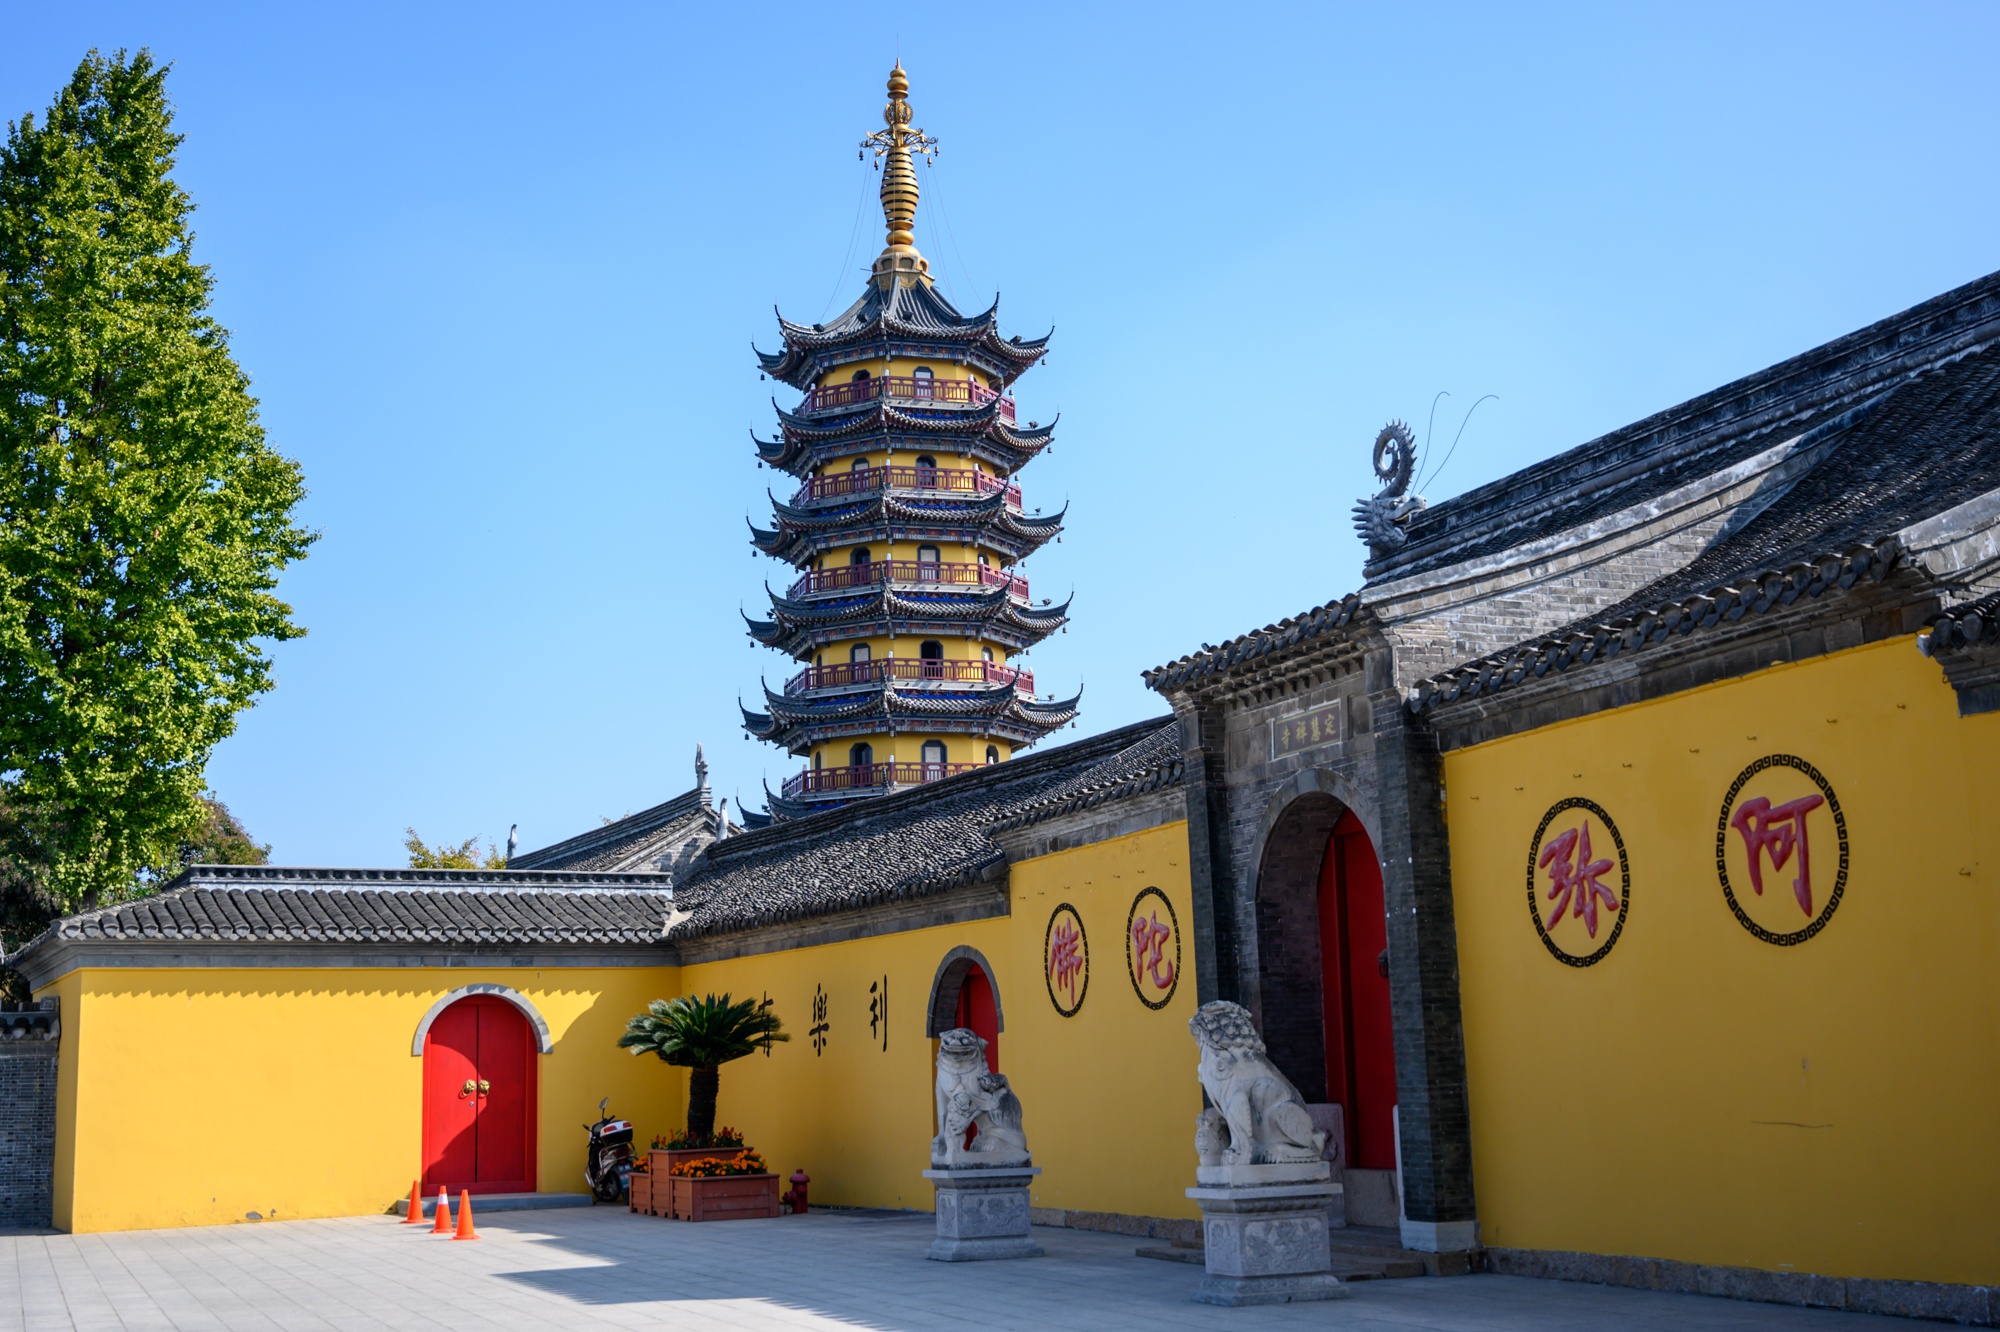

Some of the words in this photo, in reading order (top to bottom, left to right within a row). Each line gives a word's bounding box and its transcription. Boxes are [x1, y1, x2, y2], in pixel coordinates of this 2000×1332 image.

[1730, 793, 1825, 917] 阿
[1131, 909, 1174, 990] 陀
[869, 973, 888, 1053] 利
